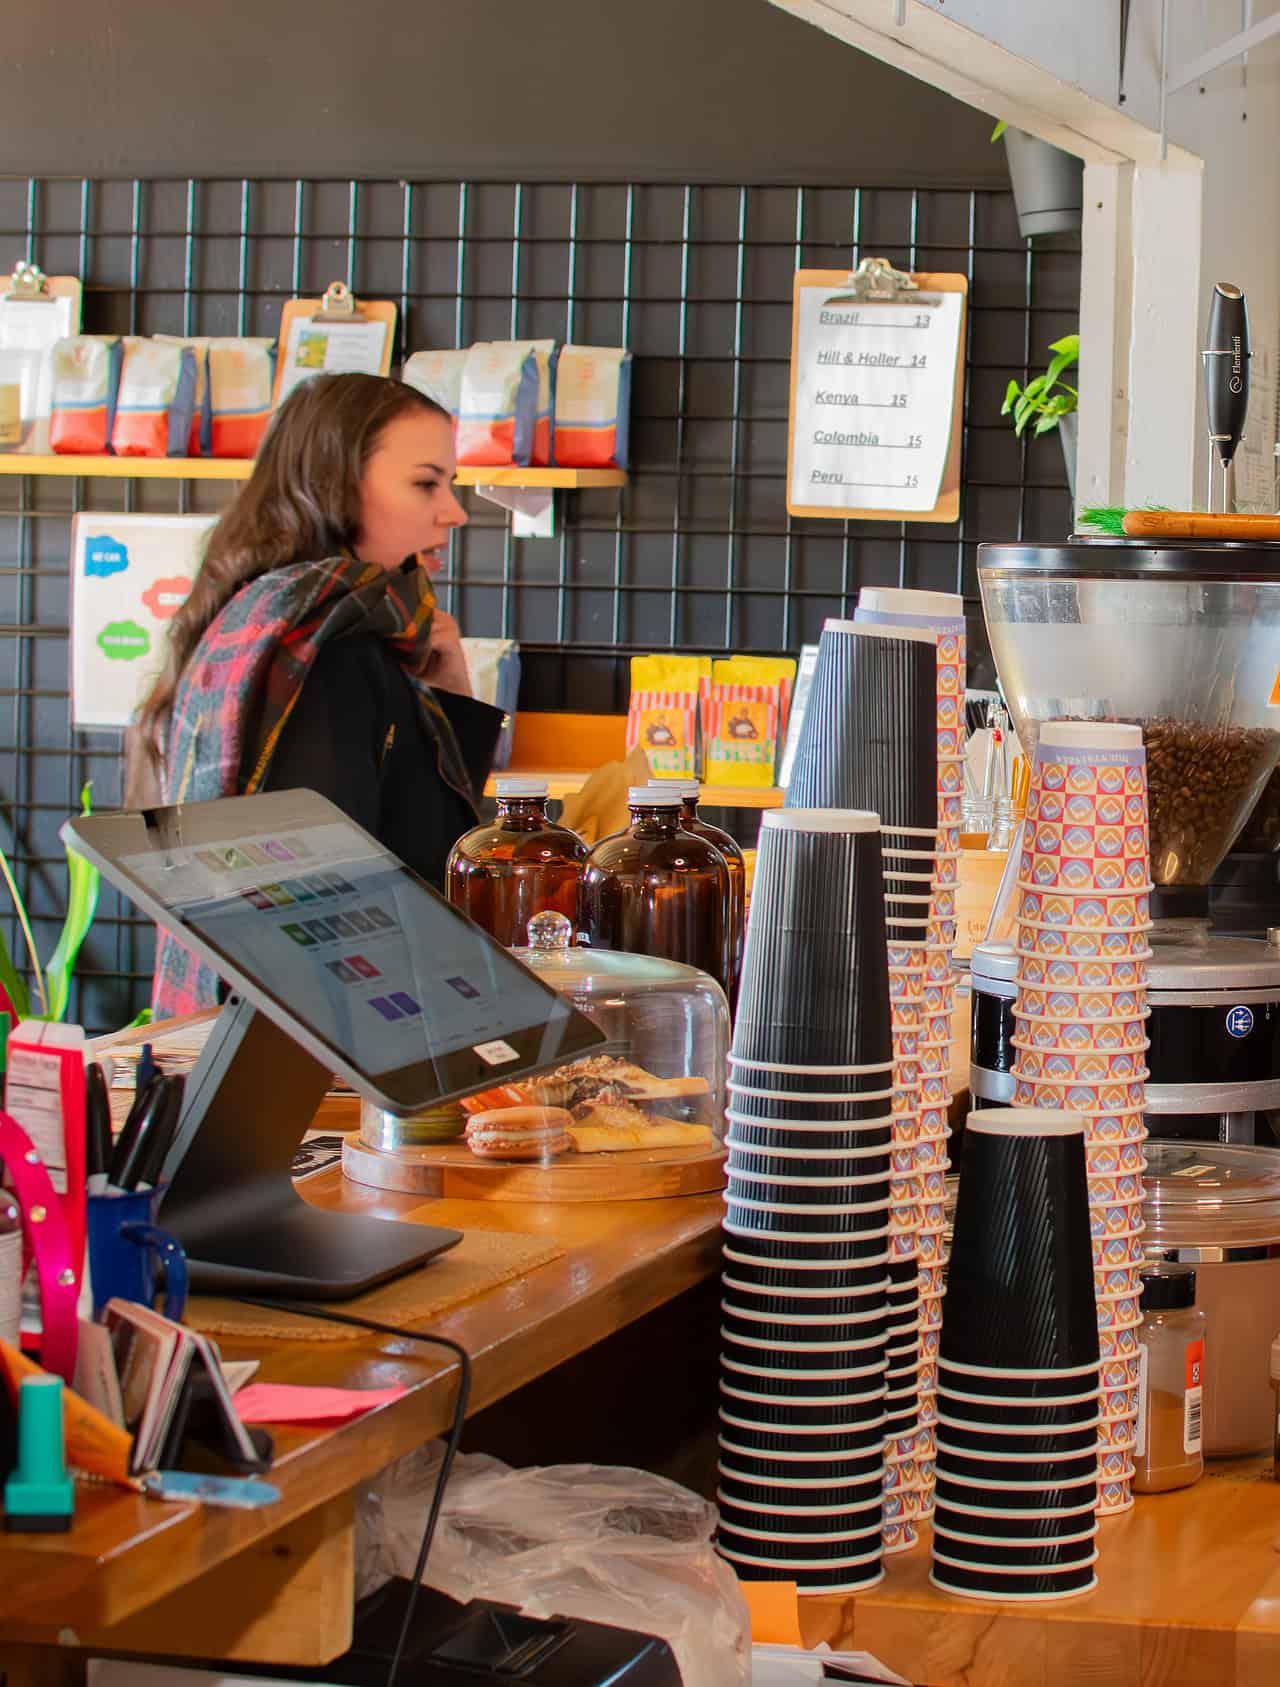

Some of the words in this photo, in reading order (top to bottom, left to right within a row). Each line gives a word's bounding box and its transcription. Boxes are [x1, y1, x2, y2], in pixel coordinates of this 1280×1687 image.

[819, 311, 860, 325] Brazil
[818, 351, 841, 363] Hill
[843, 352, 854, 365] &
[858, 352, 901, 366] Holler
[911, 354, 927, 367] 14
[815, 390, 859, 405] Kenya
[813, 430, 880, 446] Colombia
[907, 434, 923, 448] 15
[811, 470, 844, 483] Peru
[905, 475, 919, 488] 15
